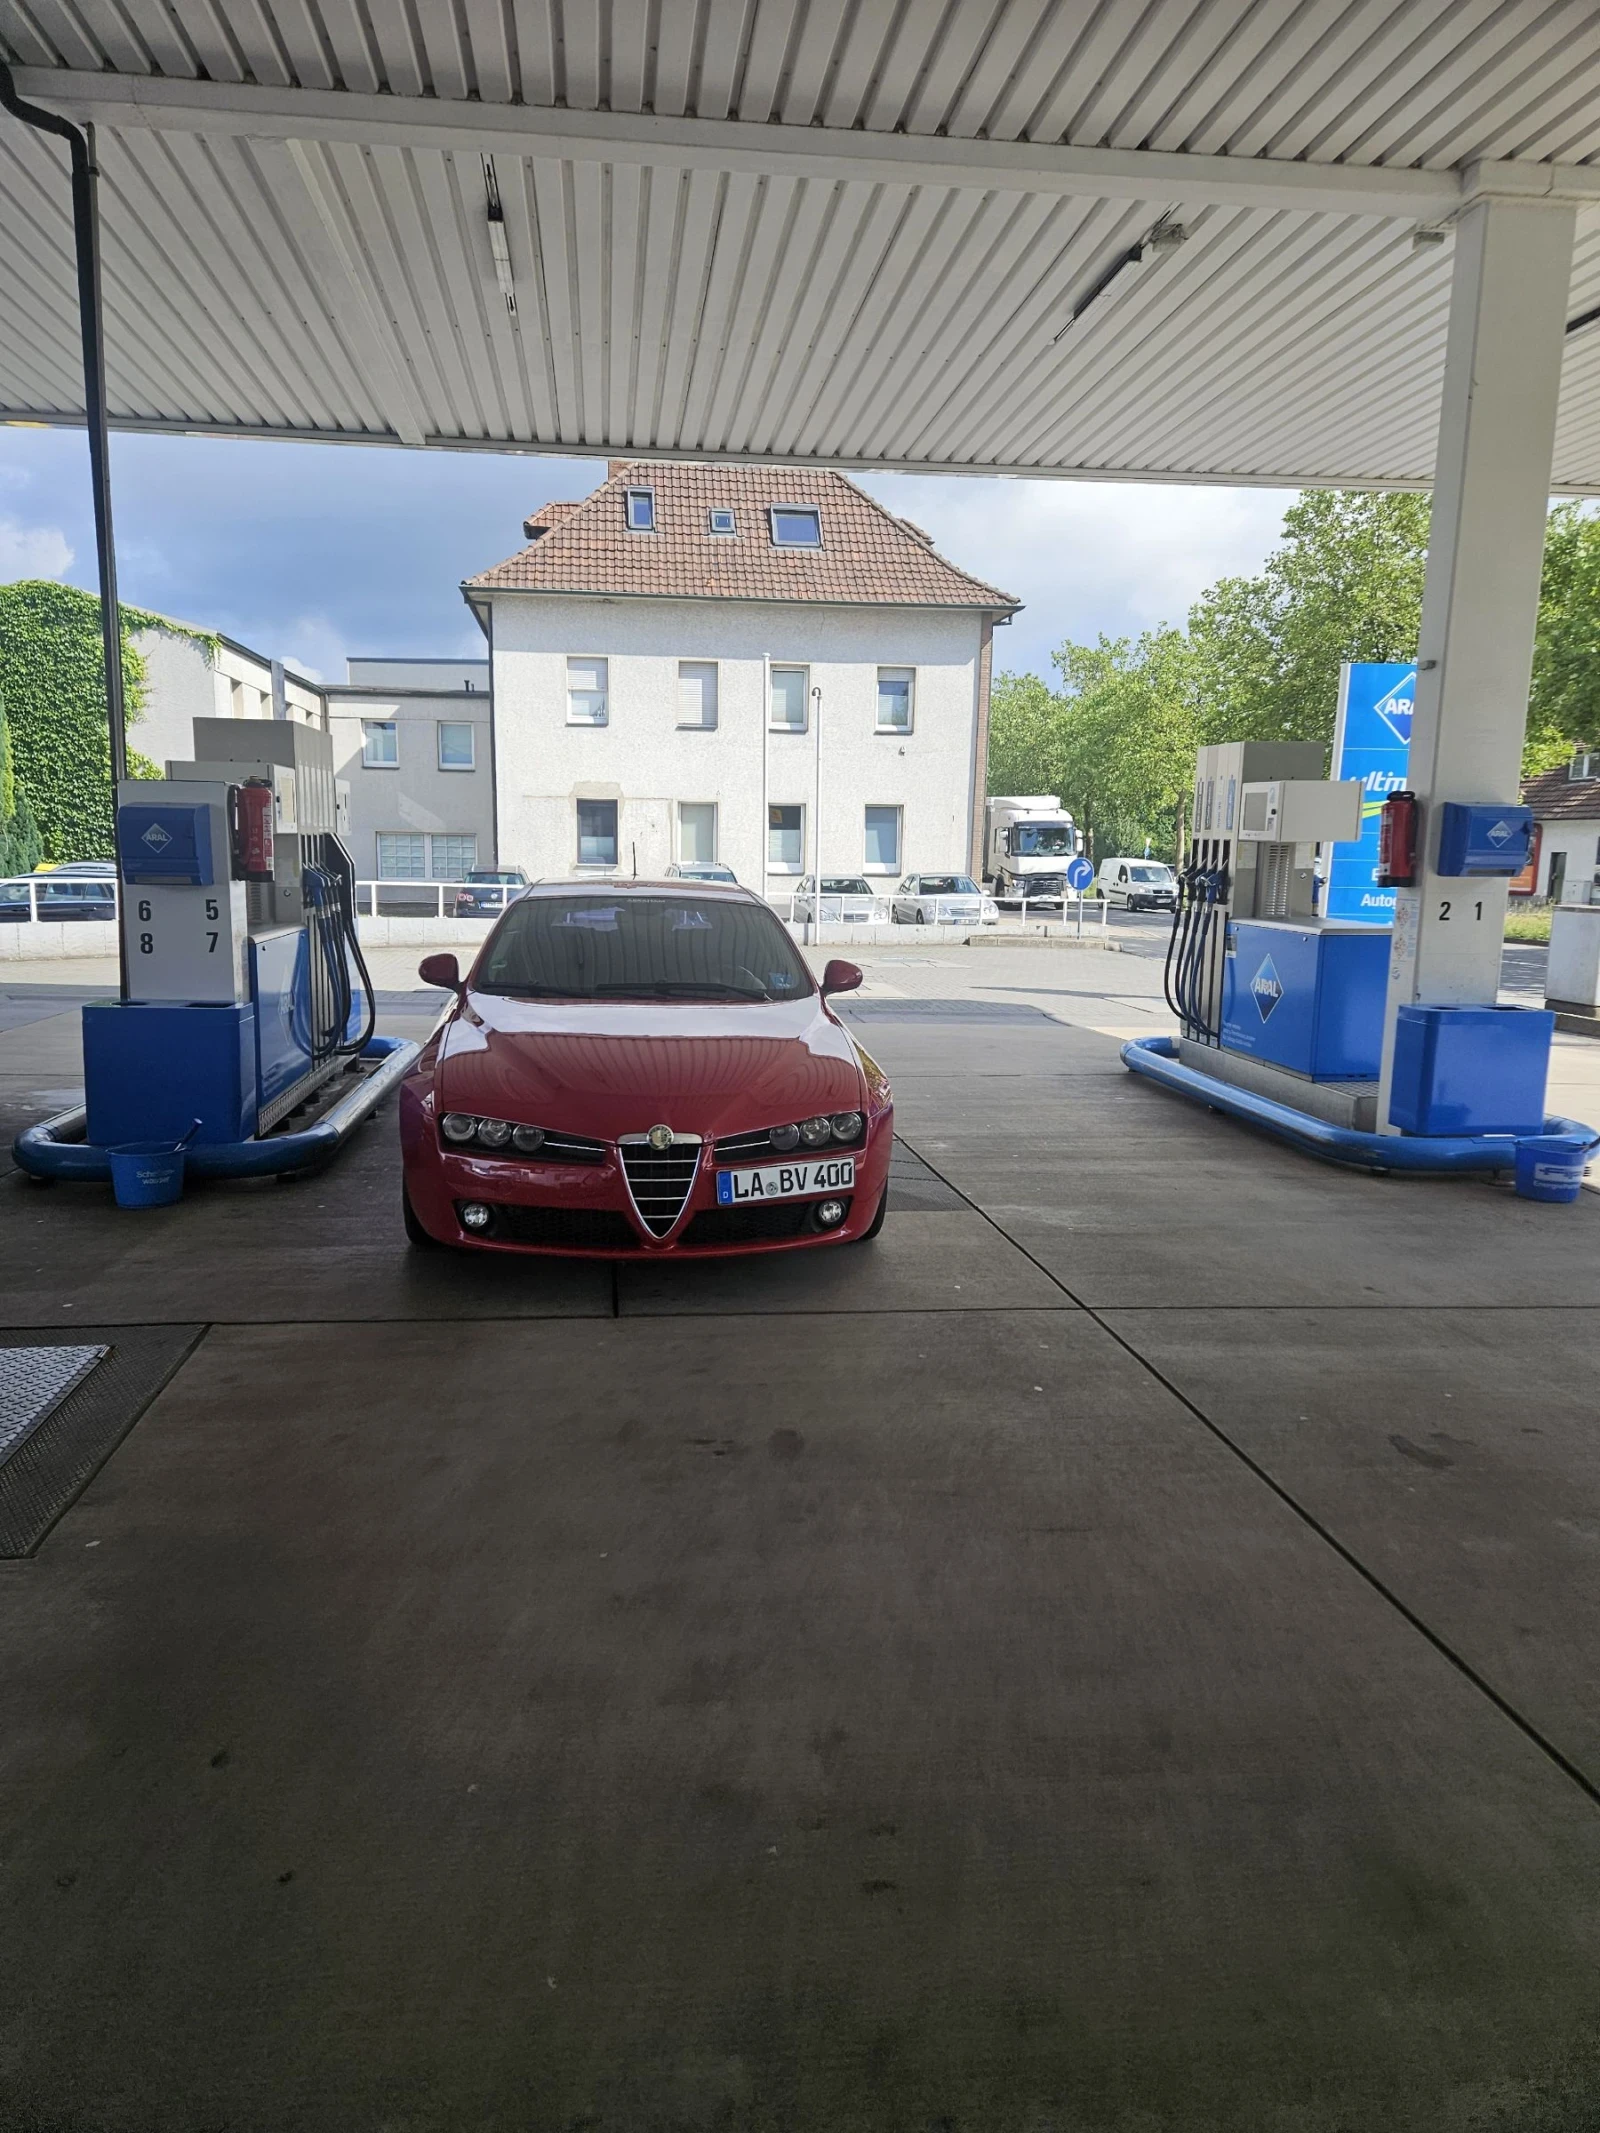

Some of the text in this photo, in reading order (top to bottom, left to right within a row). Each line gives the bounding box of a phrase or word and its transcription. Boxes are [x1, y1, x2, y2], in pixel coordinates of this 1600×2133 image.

[145, 832, 168, 842] ARAL
[138, 899, 219, 922] 6 5
[1438, 902, 1451, 921] 2
[1474, 901, 1483, 921] 1
[139, 931, 219, 954] 8 7
[1254, 978, 1279, 998] ARAL
[733, 1162, 853, 1198] LA BV 400
[722, 1190, 729, 1199] D
